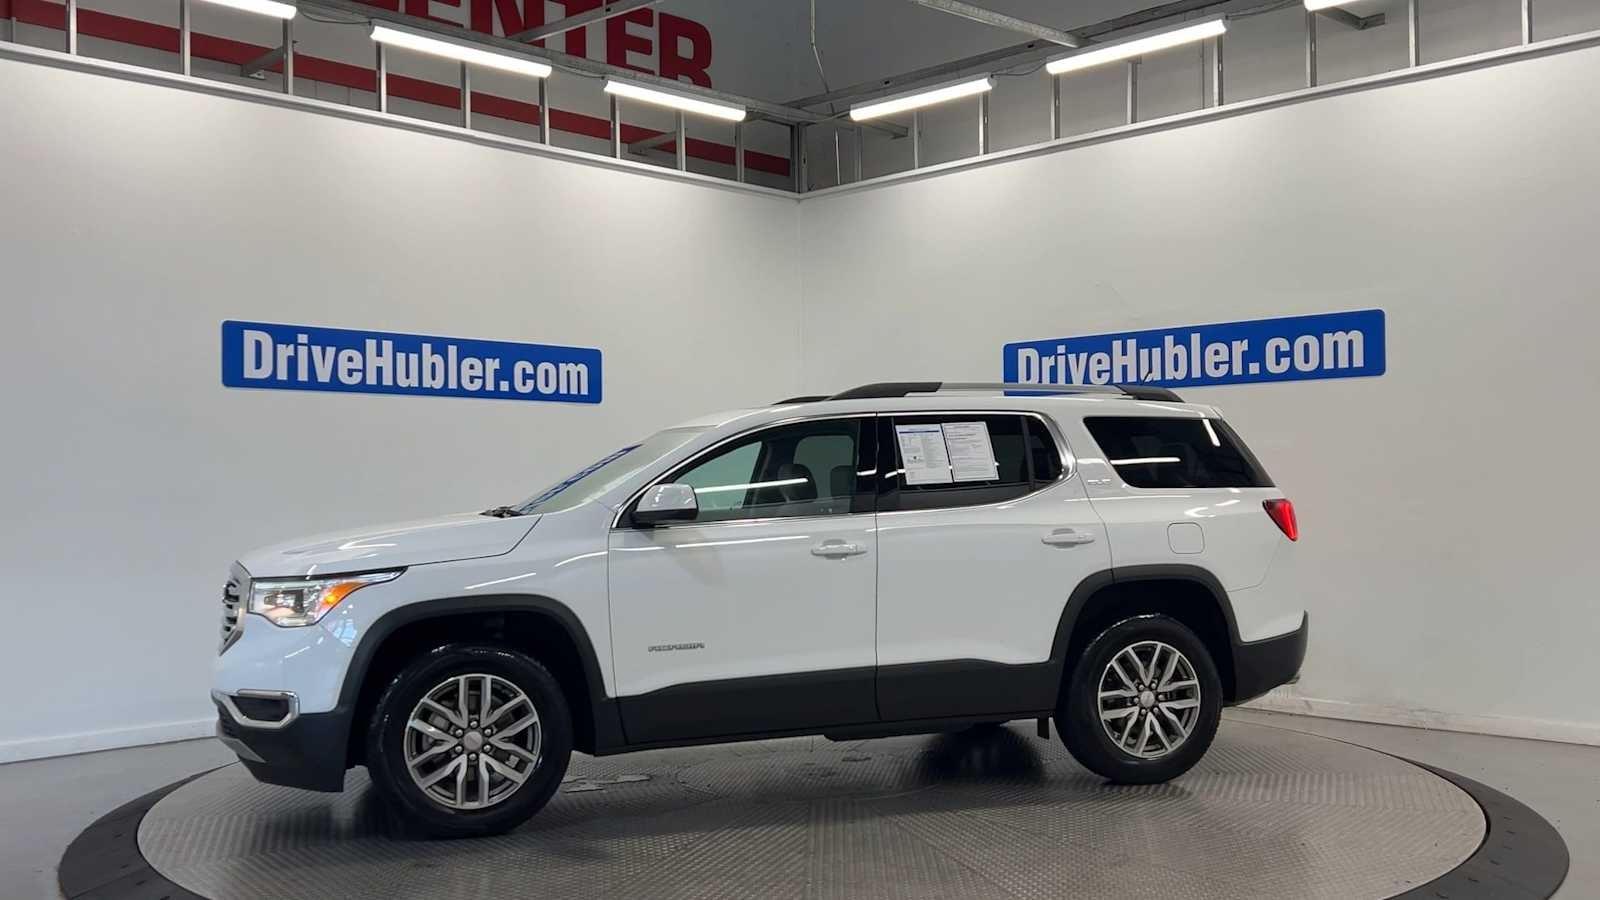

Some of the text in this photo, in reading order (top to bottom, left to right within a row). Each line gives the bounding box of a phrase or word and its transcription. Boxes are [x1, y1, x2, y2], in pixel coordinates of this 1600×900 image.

[352, 0, 711, 88] ENTER
[243, 329, 589, 395] DriveHubler.com
[1018, 329, 1364, 385] DriveHubler.com
